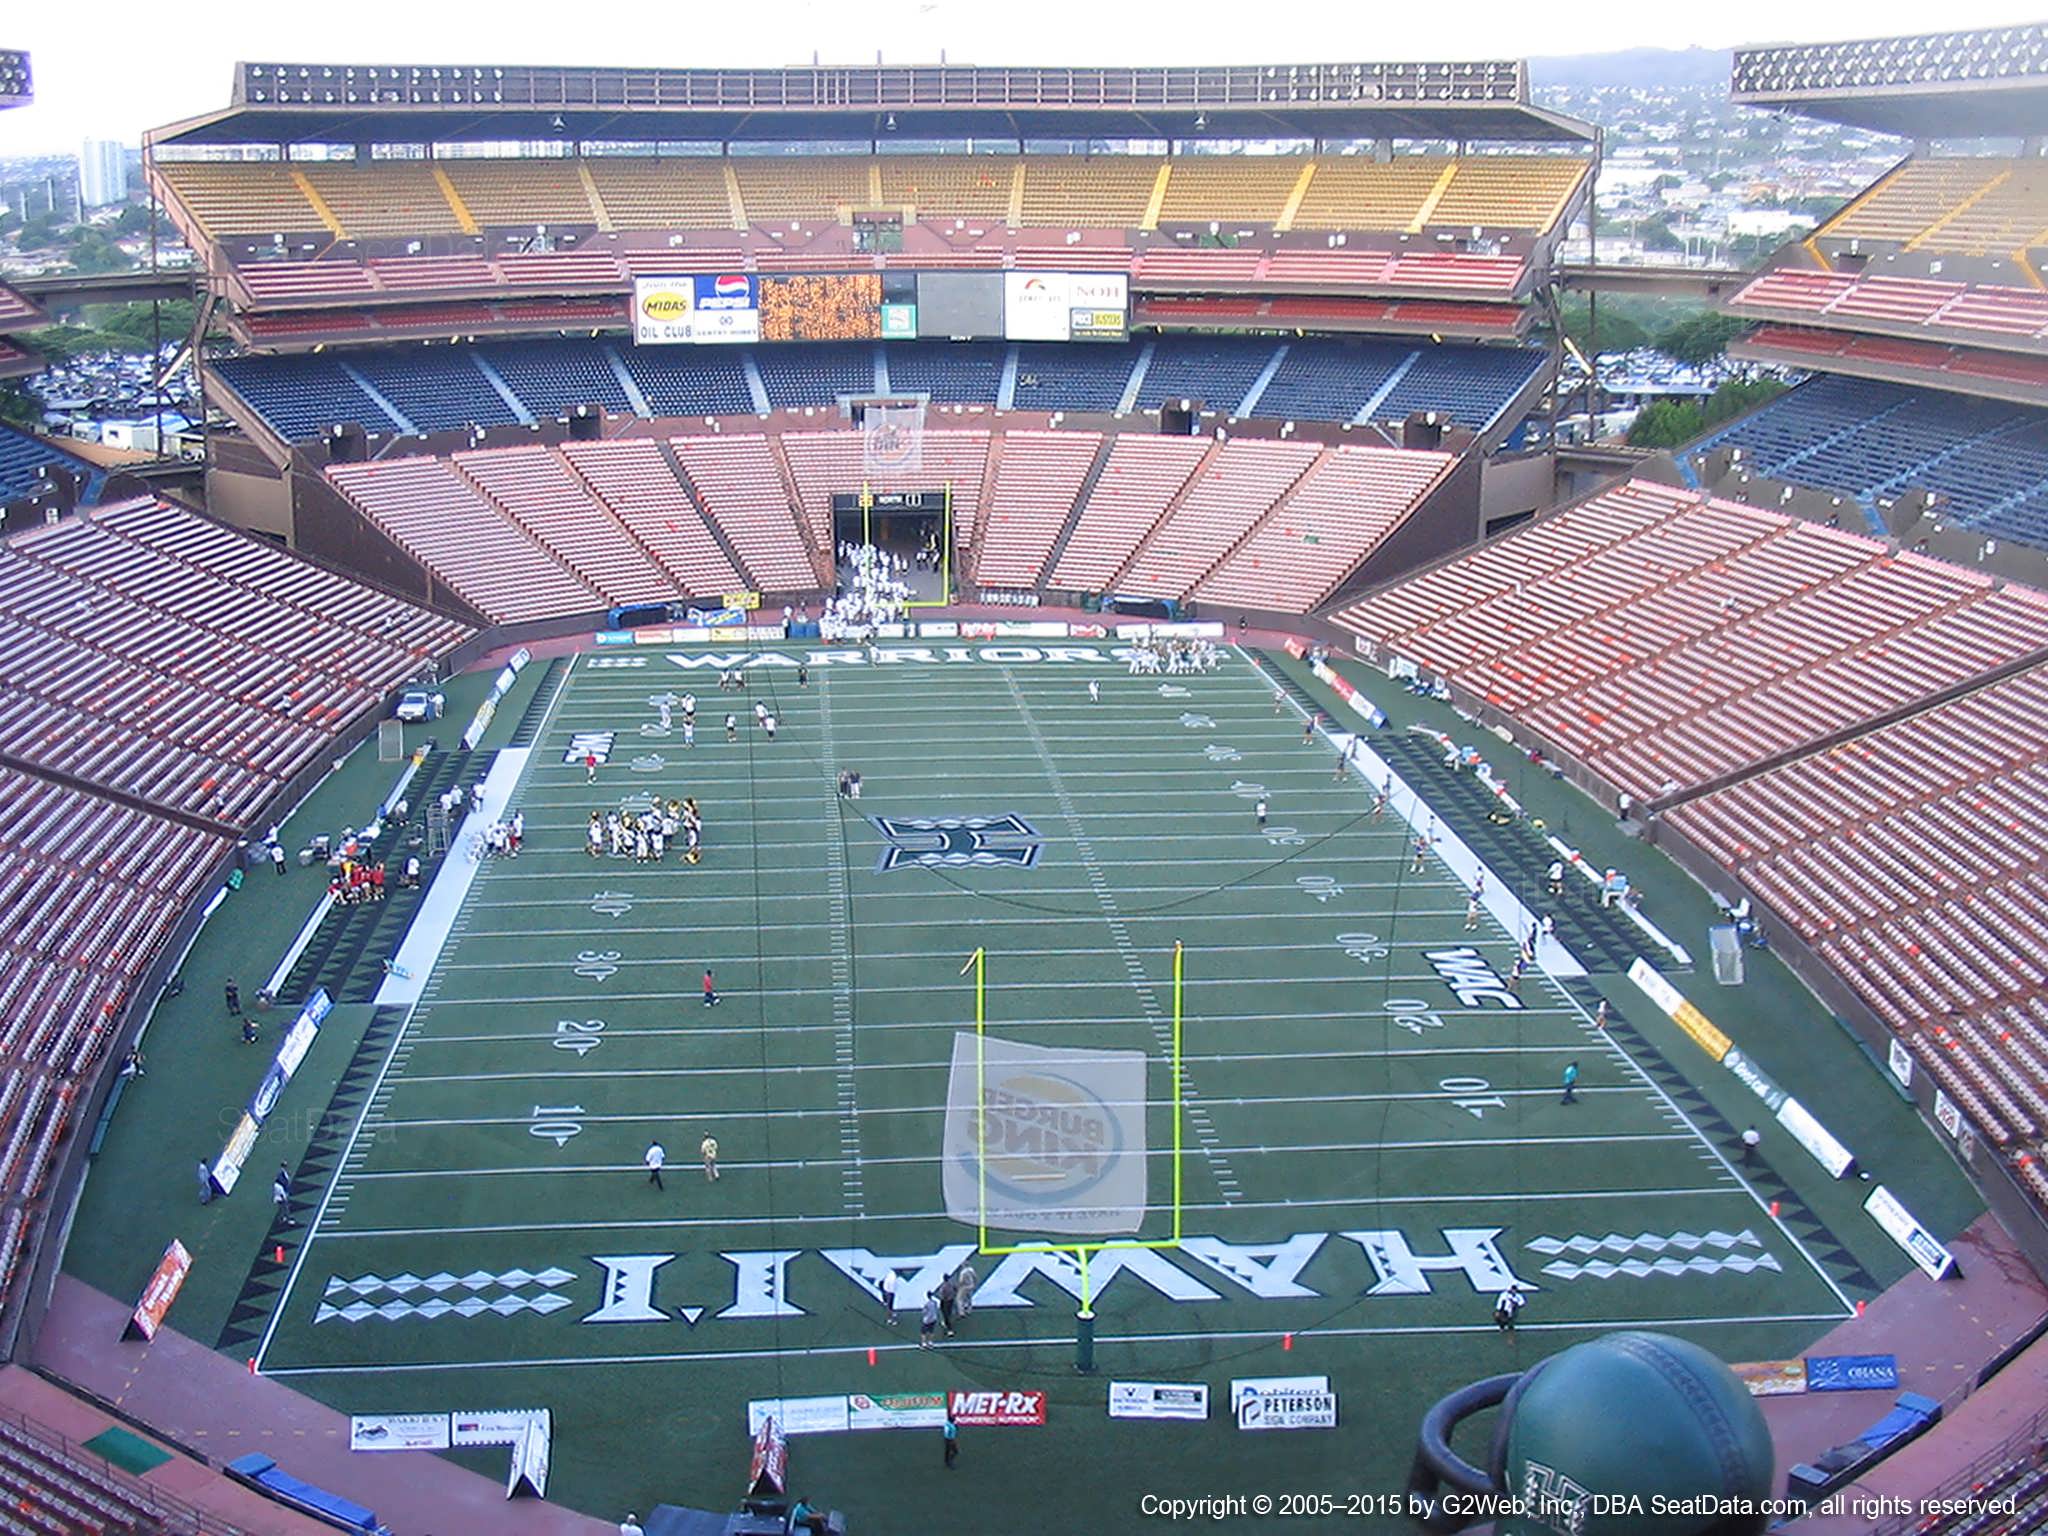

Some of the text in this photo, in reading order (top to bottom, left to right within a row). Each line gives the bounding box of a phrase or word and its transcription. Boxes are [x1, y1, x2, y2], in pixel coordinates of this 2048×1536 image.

[647, 300, 687, 312] MIDAS
[641, 325, 692, 338] OIL CLUB
[1424, 946, 1525, 1010] WAC
[1383, 1000, 1445, 1028] 20
[553, 1020, 607, 1049] 20
[1440, 1077, 1506, 1110] 10
[529, 1104, 585, 1137] 10
[582, 1227, 1541, 1325] HAWAI'I
[1847, 1366, 1895, 1378] OHANA
[1264, 1397, 1332, 1413] PETERSON
